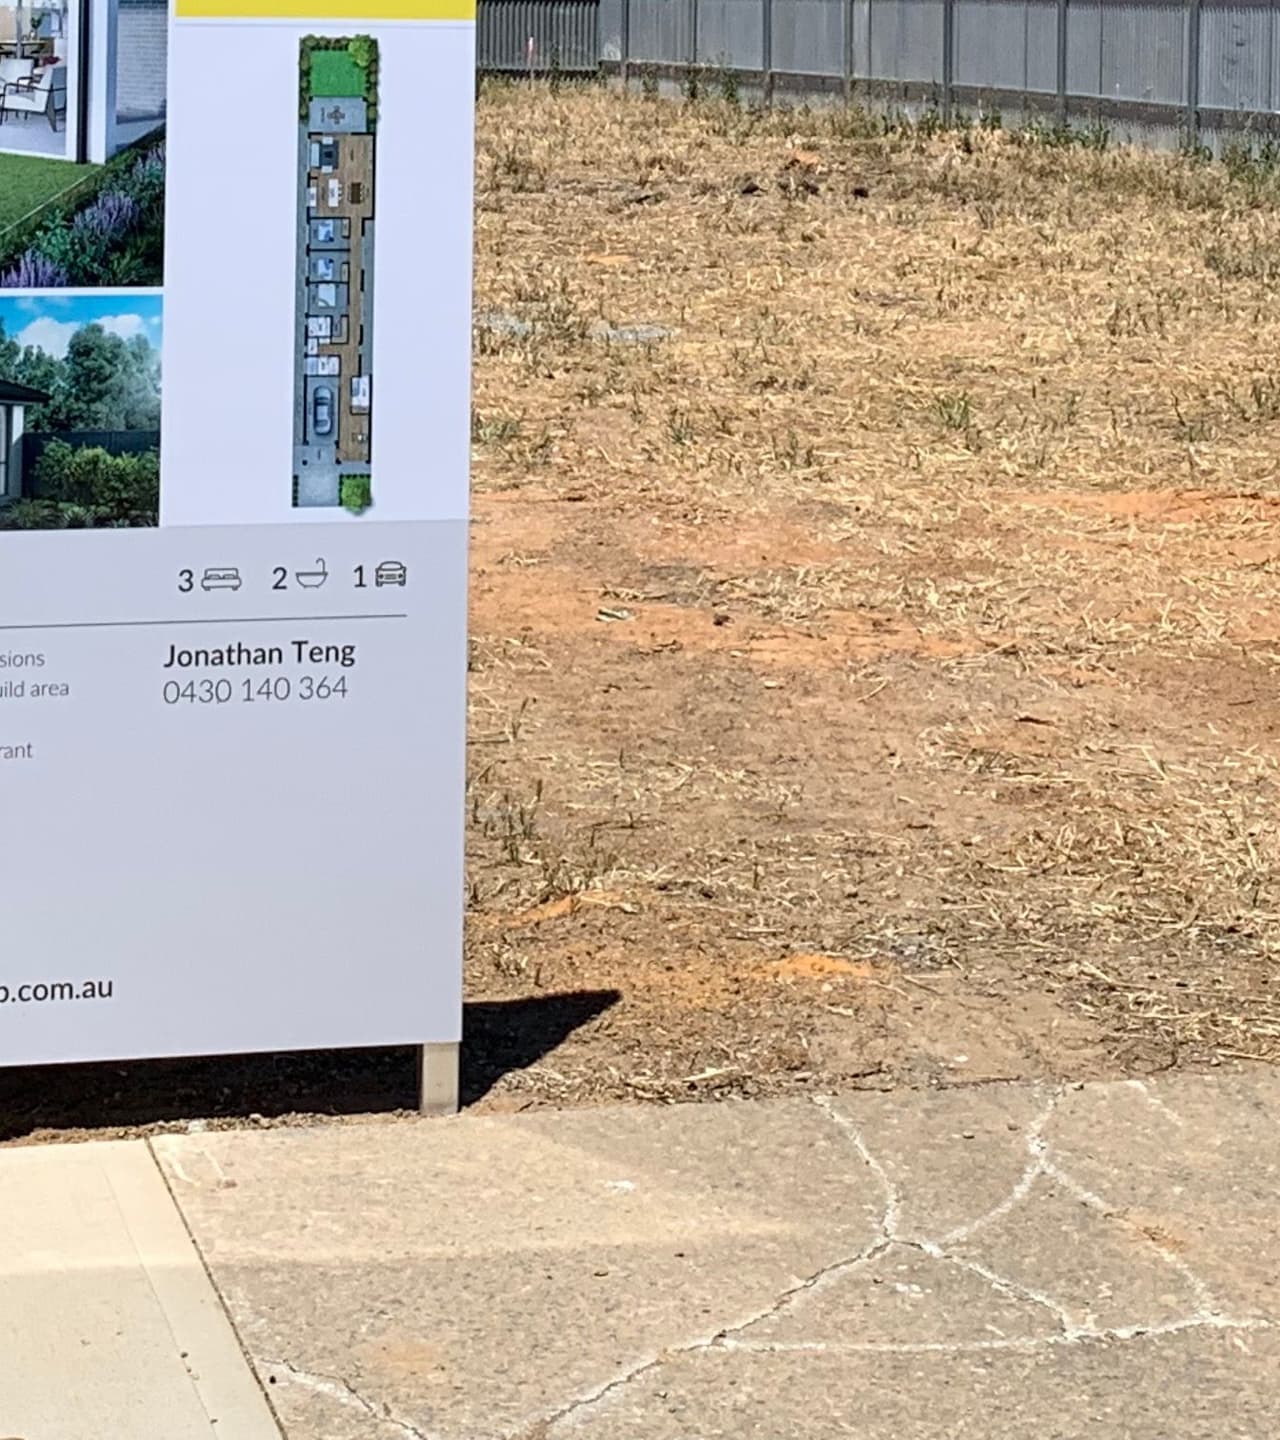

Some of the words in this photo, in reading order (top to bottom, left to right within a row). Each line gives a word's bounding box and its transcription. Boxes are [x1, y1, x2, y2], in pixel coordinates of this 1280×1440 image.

[178, 569, 194, 593] 3
[272, 566, 288, 590] 2
[353, 565, 367, 588] 1
[163, 641, 283, 668] Jonathan
[291, 640, 356, 667] Teng
[30, 683, 69, 697] area
[163, 678, 232, 704] 0430
[242, 677, 291, 702] 140
[299, 675, 348, 700] 364
